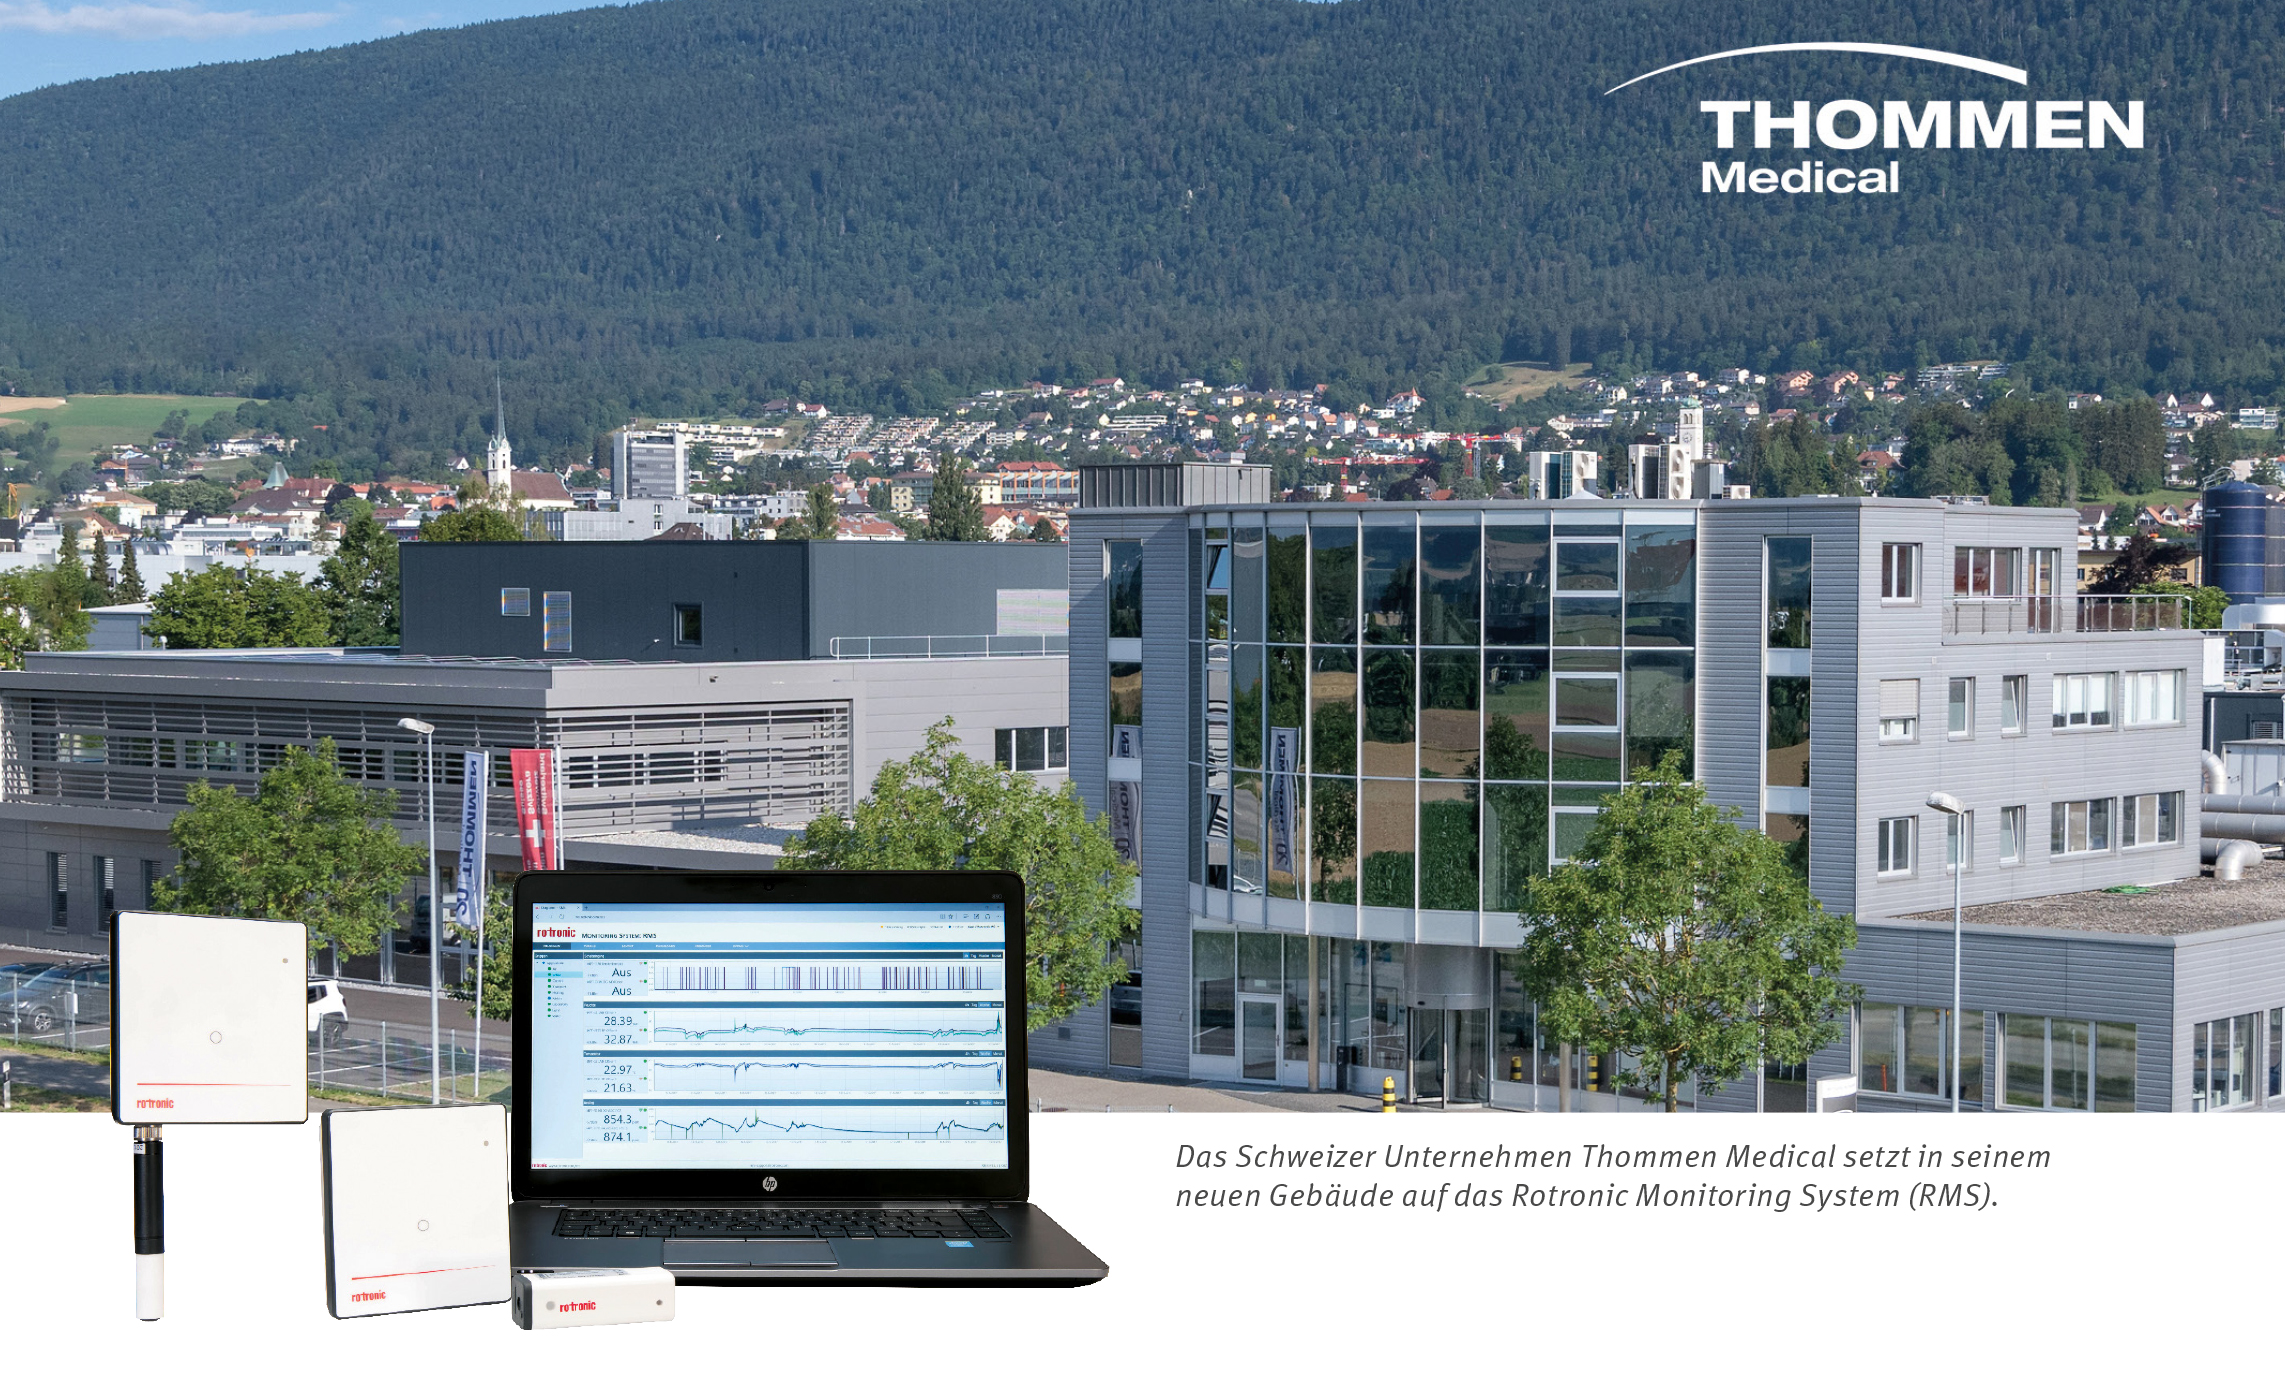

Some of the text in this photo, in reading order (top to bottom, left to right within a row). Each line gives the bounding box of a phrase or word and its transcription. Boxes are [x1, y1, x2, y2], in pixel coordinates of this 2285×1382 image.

[537, 926, 576, 938] rotronic
[611, 968, 632, 977] Aus
[611, 986, 632, 996] Aus
[604, 1016, 633, 1026] 28.39
[604, 1034, 632, 1045] 32.87
[604, 1065, 632, 1075] 22.97
[603, 1083, 632, 1093] 21.63
[136, 1097, 174, 1109] rotronic
[604, 1115, 632, 1124] 854.3
[603, 1132, 631, 1142] 874.1
[763, 1176, 778, 1192] hp
[351, 1289, 386, 1302] rotronic
[559, 1300, 597, 1313] rotronic
